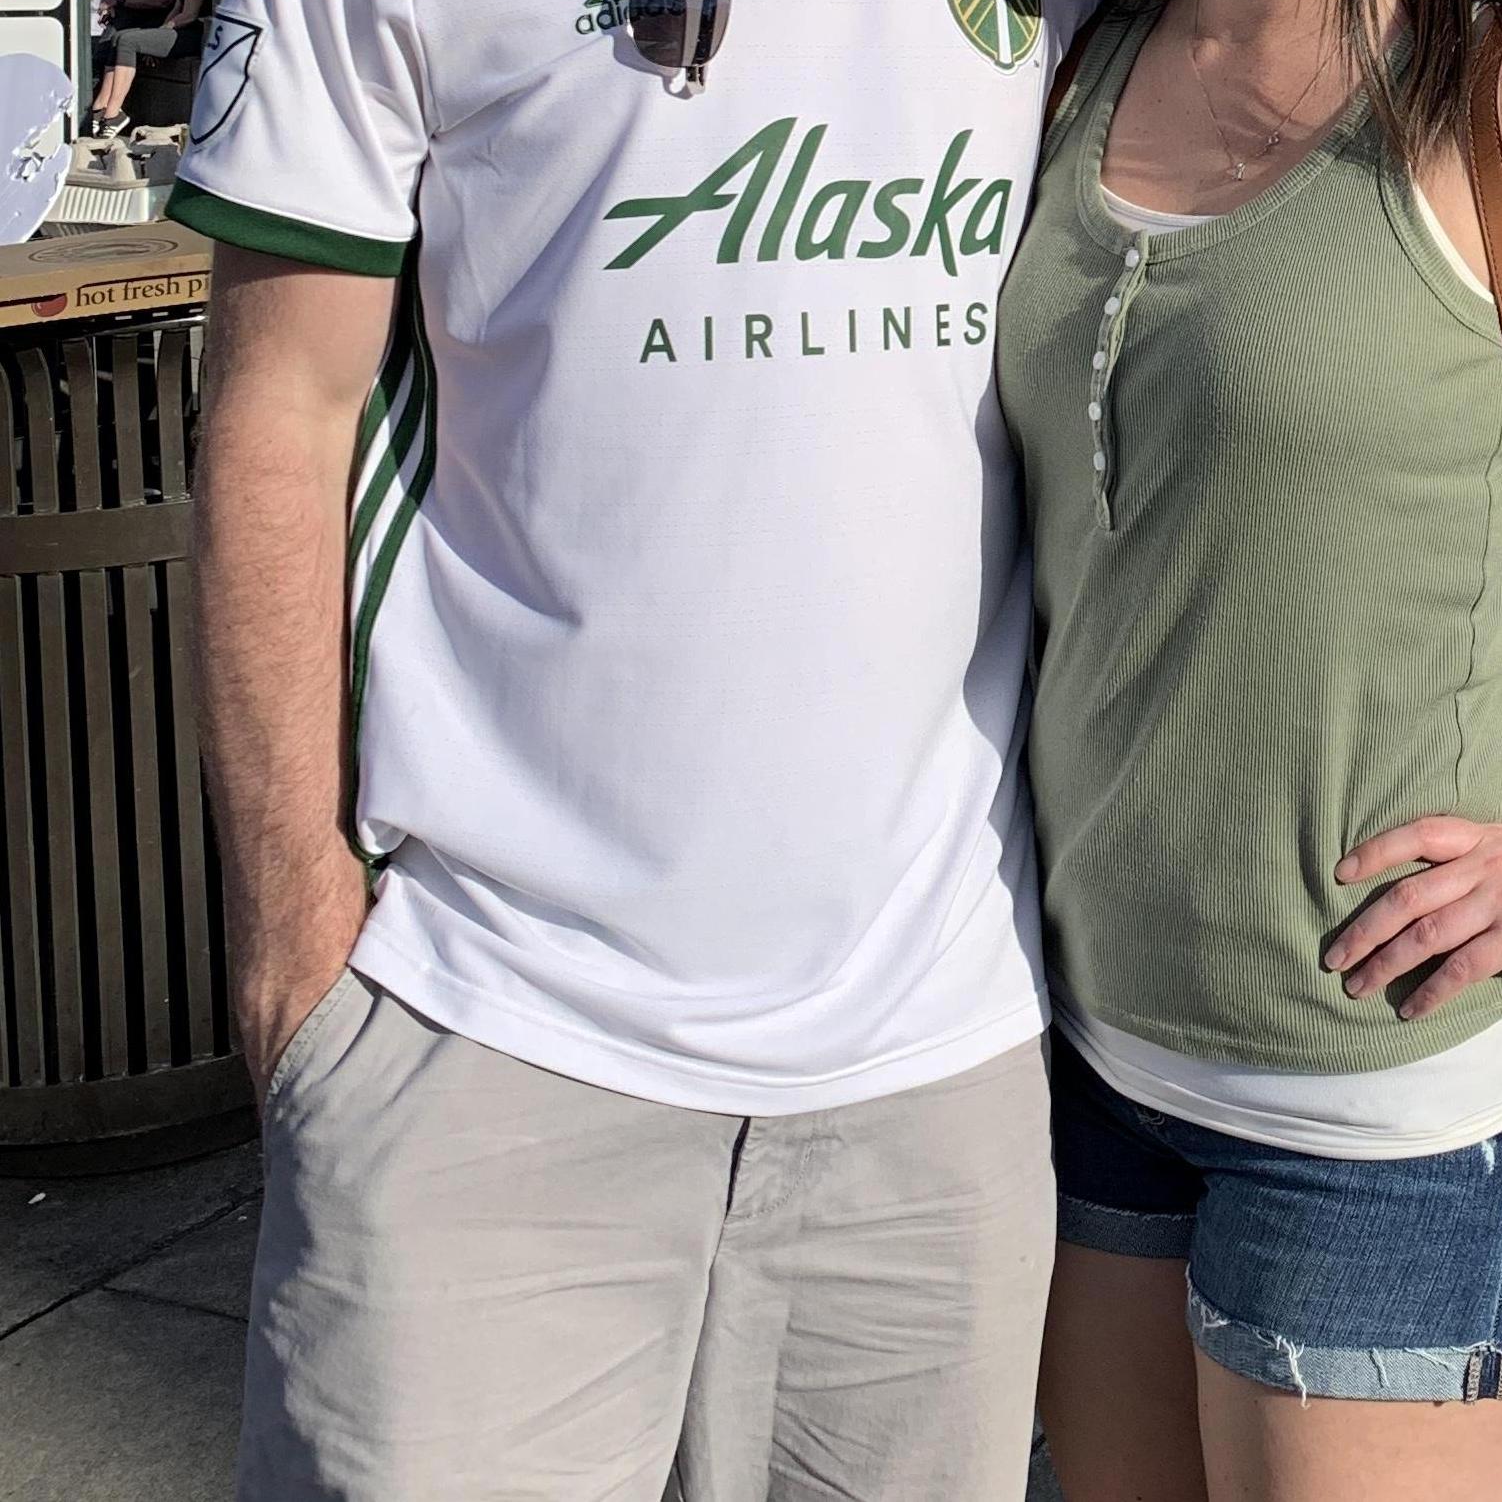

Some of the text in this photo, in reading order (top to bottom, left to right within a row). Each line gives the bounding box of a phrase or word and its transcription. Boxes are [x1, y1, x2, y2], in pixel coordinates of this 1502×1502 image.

[603, 117, 1013, 277] Alaska
[76, 286, 116, 307] hot
[123, 276, 180, 301] fresh
[639, 301, 989, 364] AIRLINES
